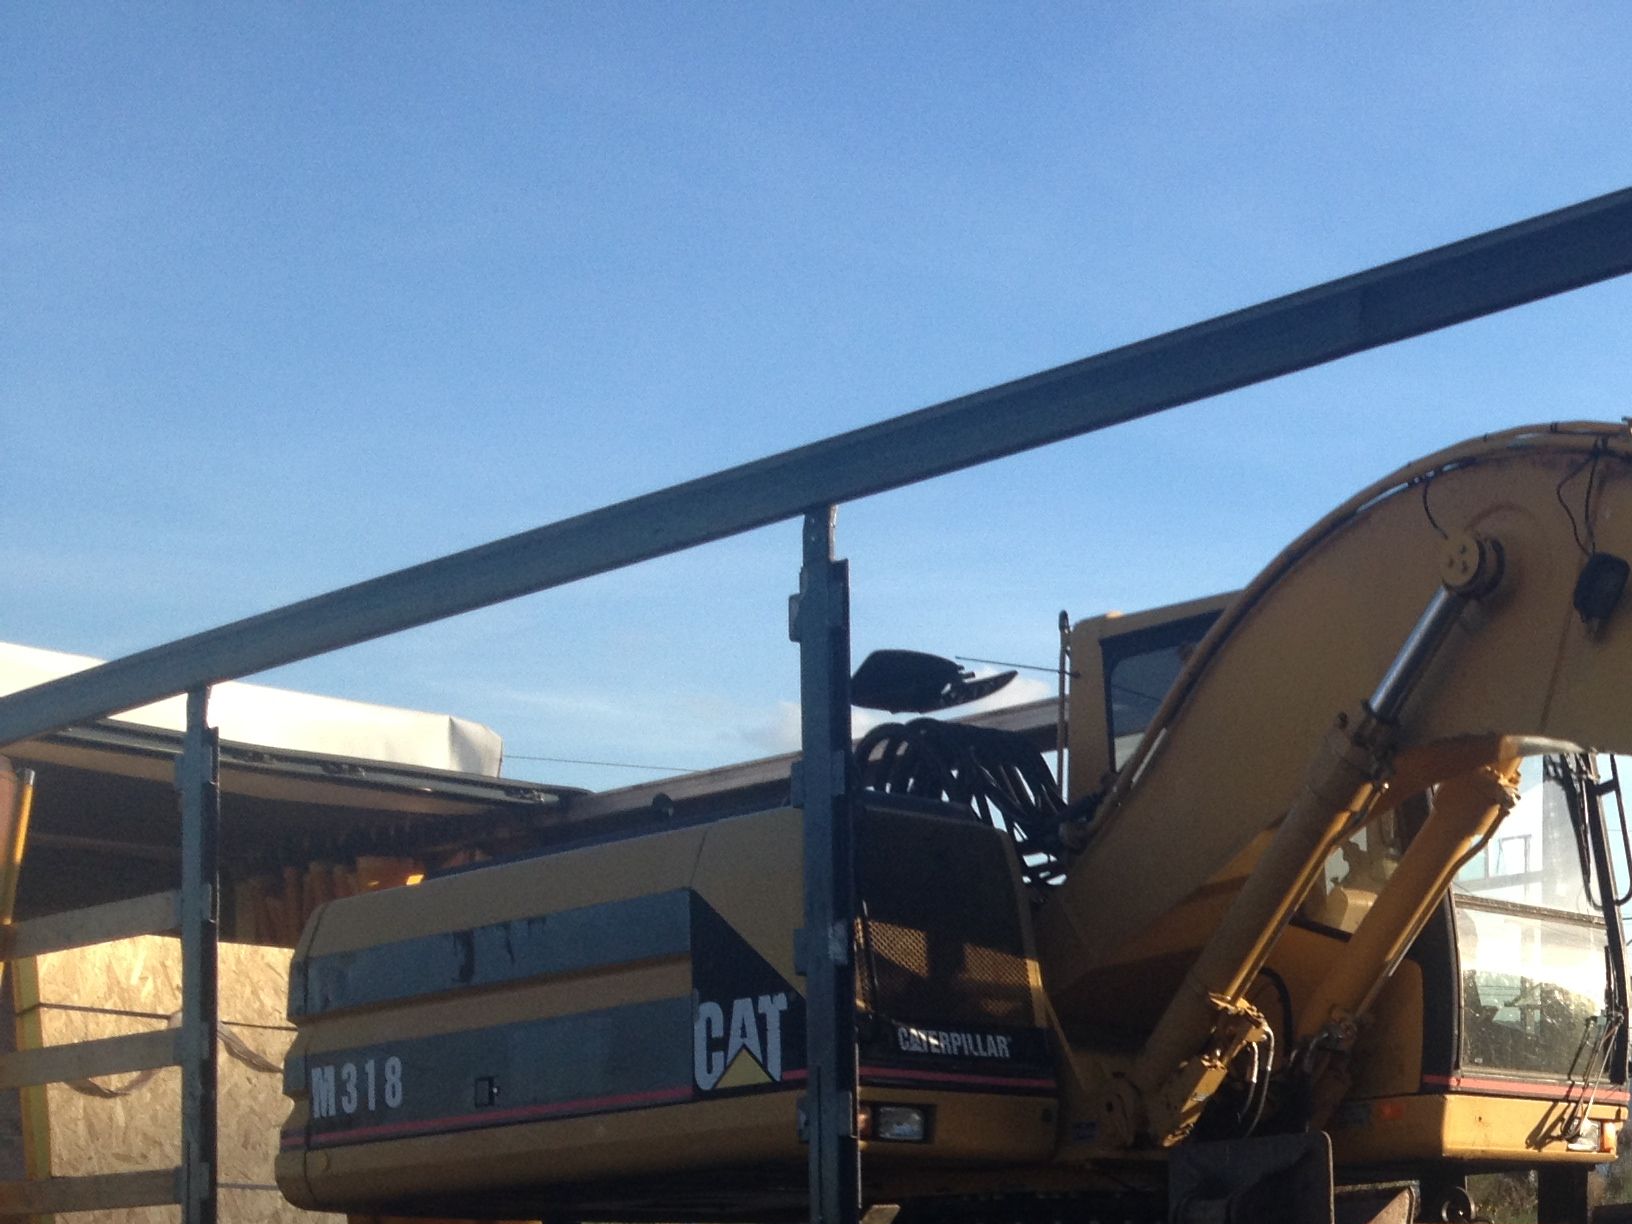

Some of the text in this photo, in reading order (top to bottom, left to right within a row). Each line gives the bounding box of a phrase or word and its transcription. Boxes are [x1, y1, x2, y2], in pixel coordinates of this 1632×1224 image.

[694, 993, 788, 1091] CAT
[898, 1027, 1011, 1058] CATERPILLAR
[311, 1056, 402, 1119] M318
